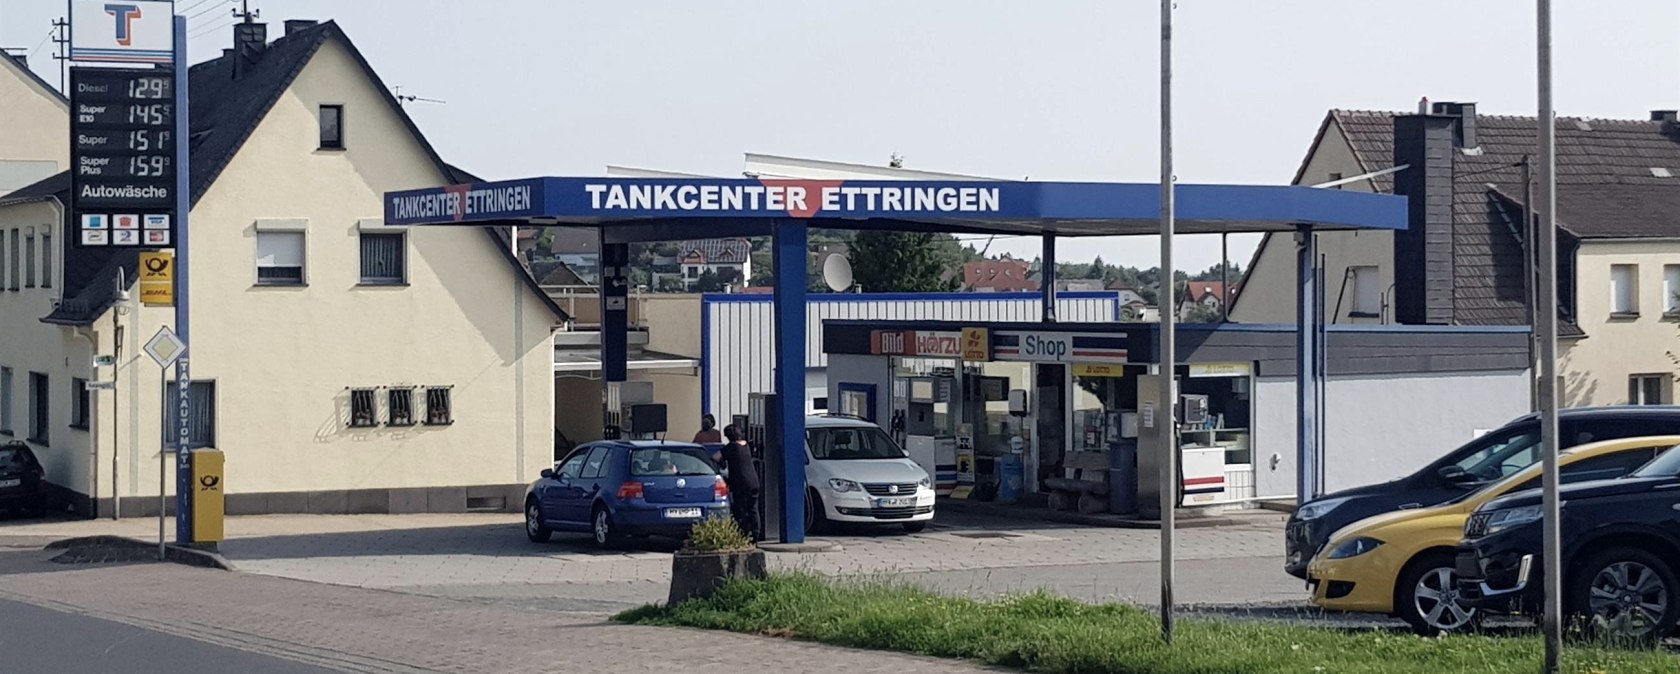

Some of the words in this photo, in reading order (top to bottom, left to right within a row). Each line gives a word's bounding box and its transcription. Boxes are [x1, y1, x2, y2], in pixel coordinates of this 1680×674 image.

[104, 4, 141, 46] T
[78, 83, 108, 92] Diesel
[80, 105, 106, 114] Super
[80, 114, 94, 122] E10
[79, 135, 107, 146] Super
[81, 156, 109, 166] Super
[81, 165, 101, 175] Plus
[82, 184, 167, 198] Autowäsche
[393, 191, 461, 219] TANKCENTER
[465, 185, 531, 215] ETTRINGEN
[585, 184, 807, 211] TANKCENTER
[821, 187, 999, 212] ETTRINGEN
[1025, 335, 1066, 361] Shop
[964, 351, 984, 359] LOTTO
[180, 363, 189, 463] TANKAUTOMAT
